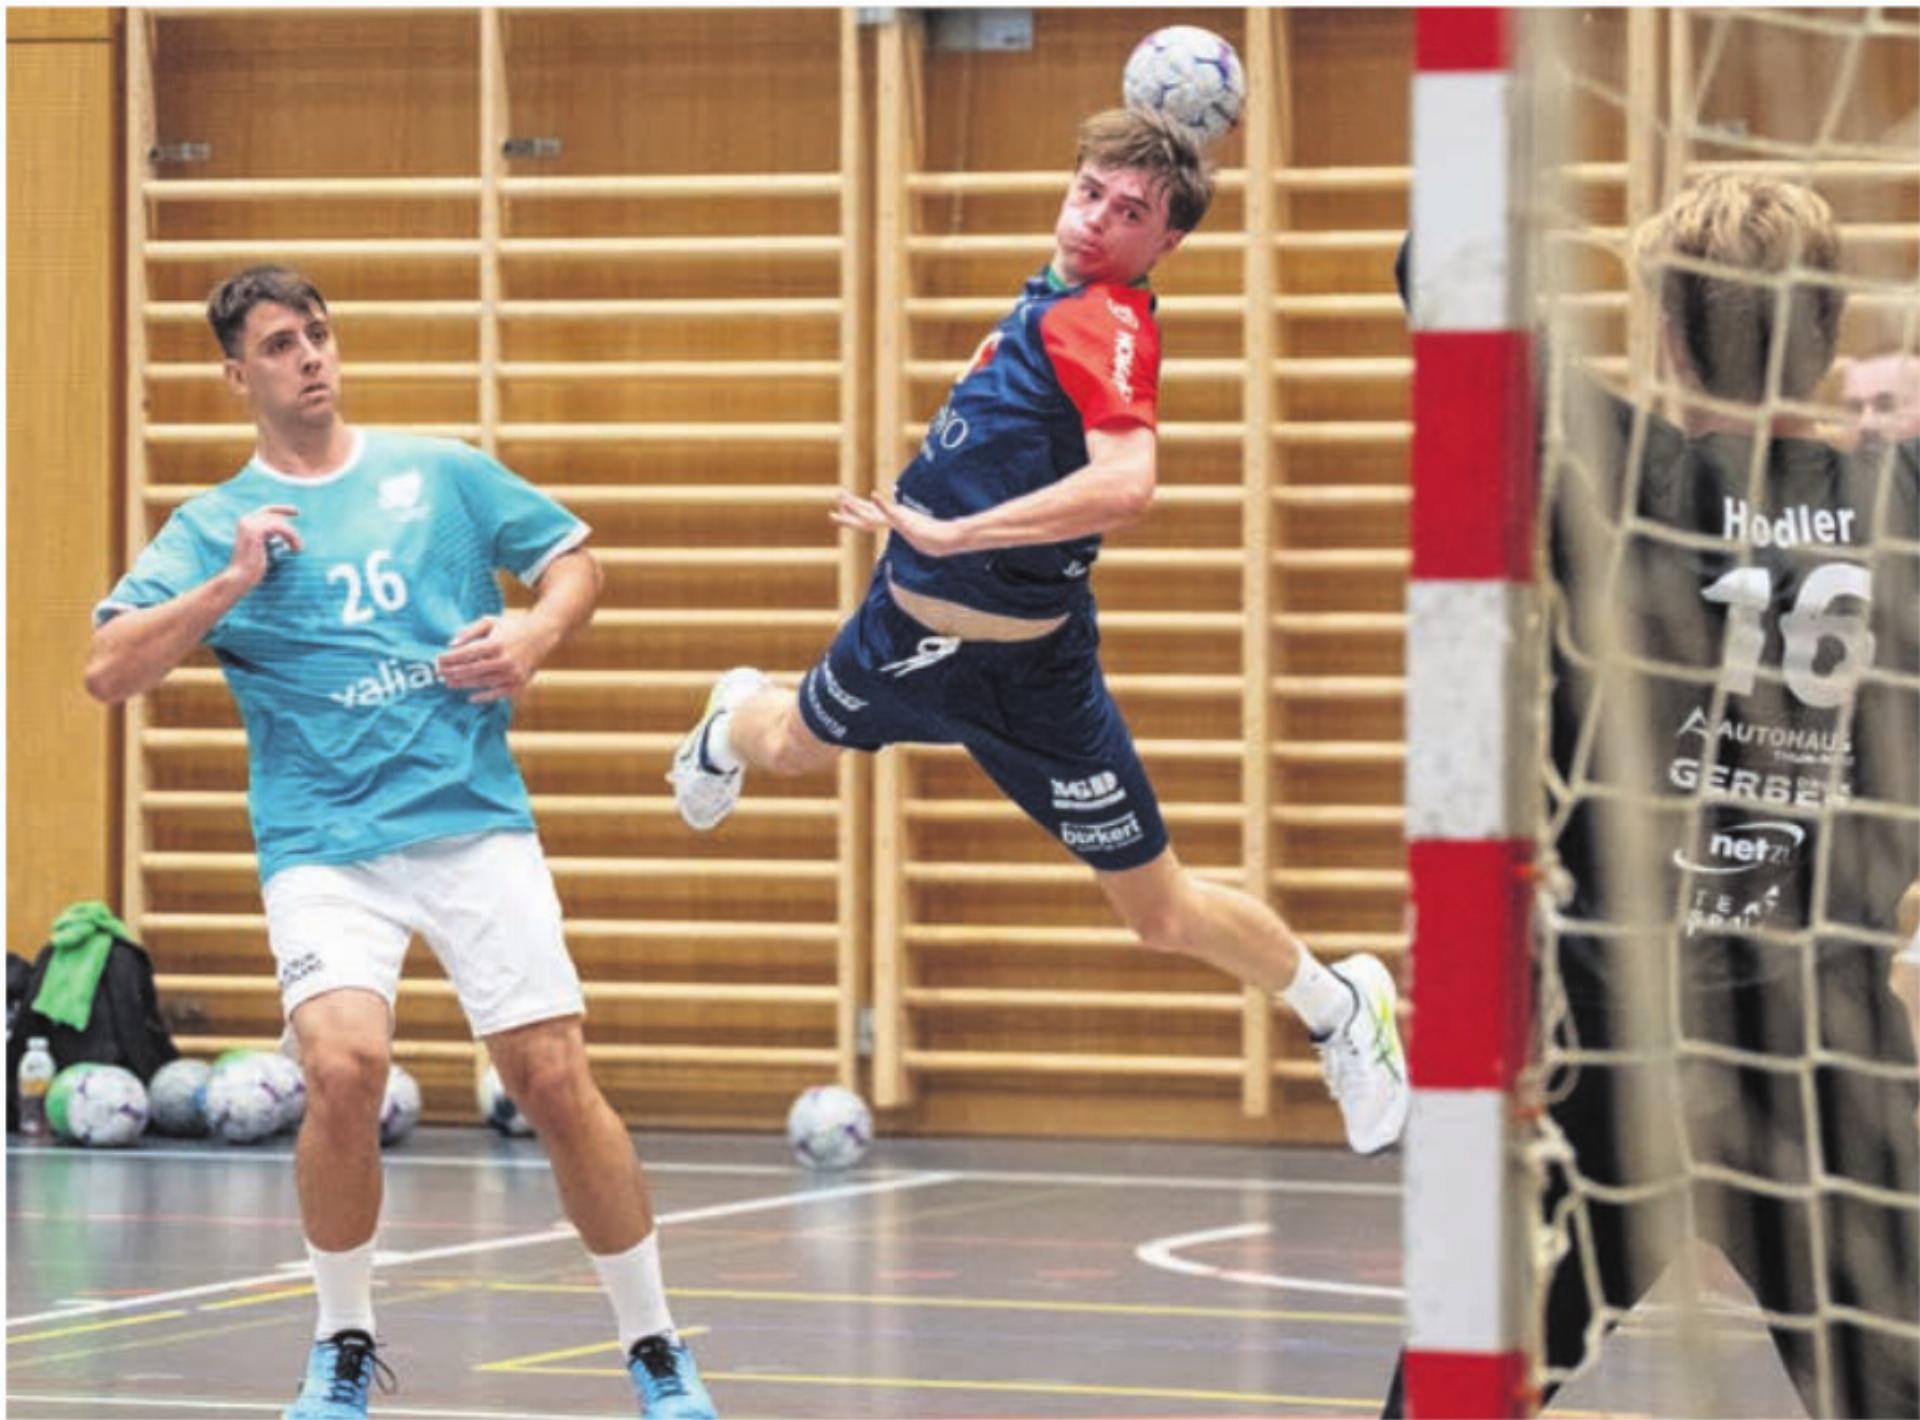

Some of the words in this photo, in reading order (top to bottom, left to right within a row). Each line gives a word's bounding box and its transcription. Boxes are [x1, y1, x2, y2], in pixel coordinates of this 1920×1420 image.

[1722, 496, 1856, 548] Hodler
[326, 549, 407, 626] 26
[1699, 562, 1876, 709] 16
